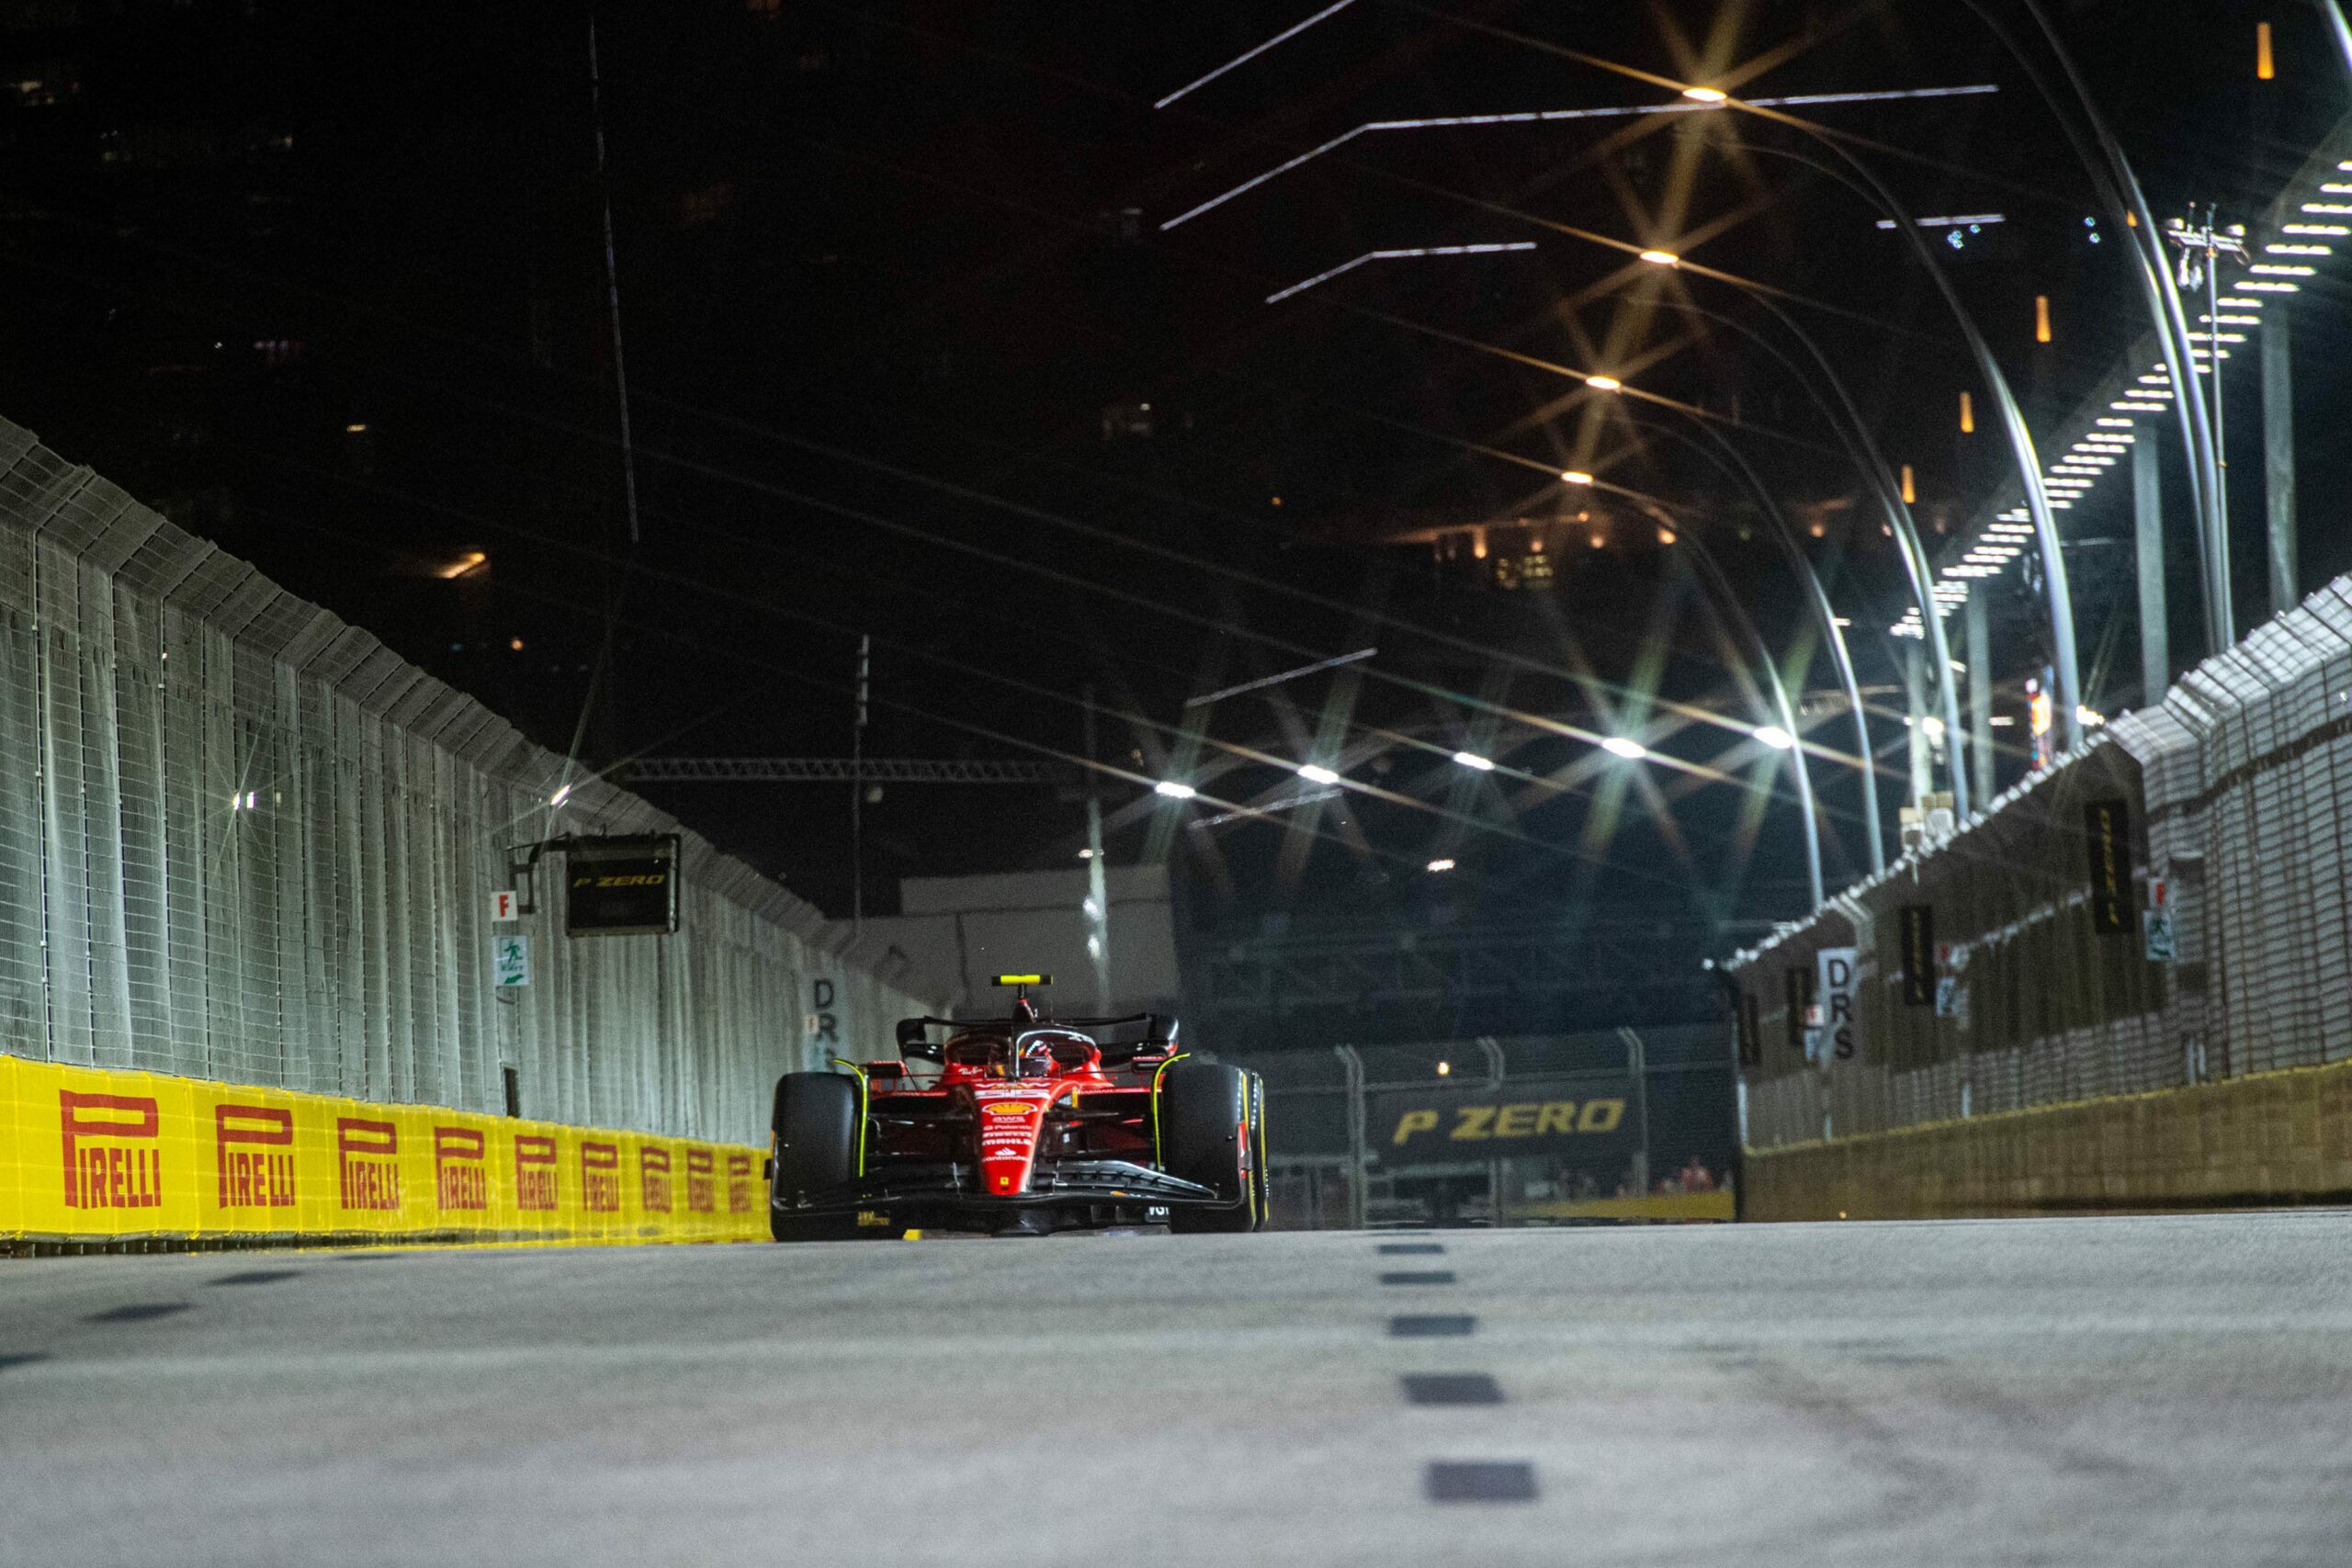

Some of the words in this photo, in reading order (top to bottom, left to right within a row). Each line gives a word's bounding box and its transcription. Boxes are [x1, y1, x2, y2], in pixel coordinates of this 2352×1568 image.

[499, 895, 509, 917] F
[596, 874, 665, 887] ZERO
[1827, 958, 1854, 1060] DRS
[60, 1089, 162, 1209] PIRELLI
[215, 1104, 296, 1208] PIRELLI
[337, 1118, 401, 1210] PIRELLI
[1391, 1109, 1440, 1146] P
[1450, 1098, 1626, 1142] ZERO
[435, 1126, 487, 1210] PIRELLI
